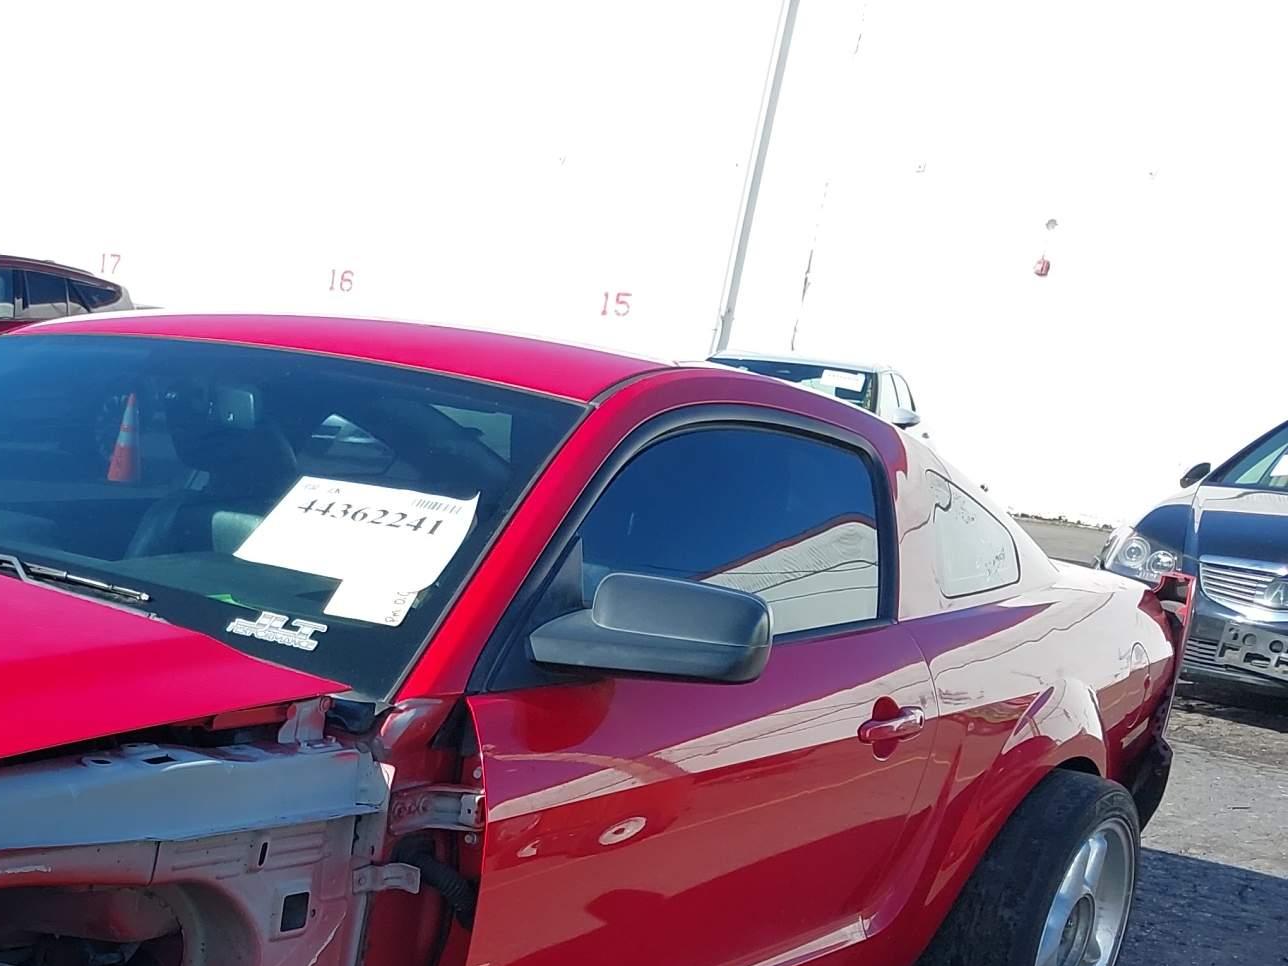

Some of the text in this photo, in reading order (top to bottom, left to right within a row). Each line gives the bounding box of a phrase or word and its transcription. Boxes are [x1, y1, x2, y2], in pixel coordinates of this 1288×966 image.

[101, 253, 121, 274] 17
[329, 269, 354, 292] 16
[601, 291, 633, 317] 15
[297, 498, 444, 536] 44362241
